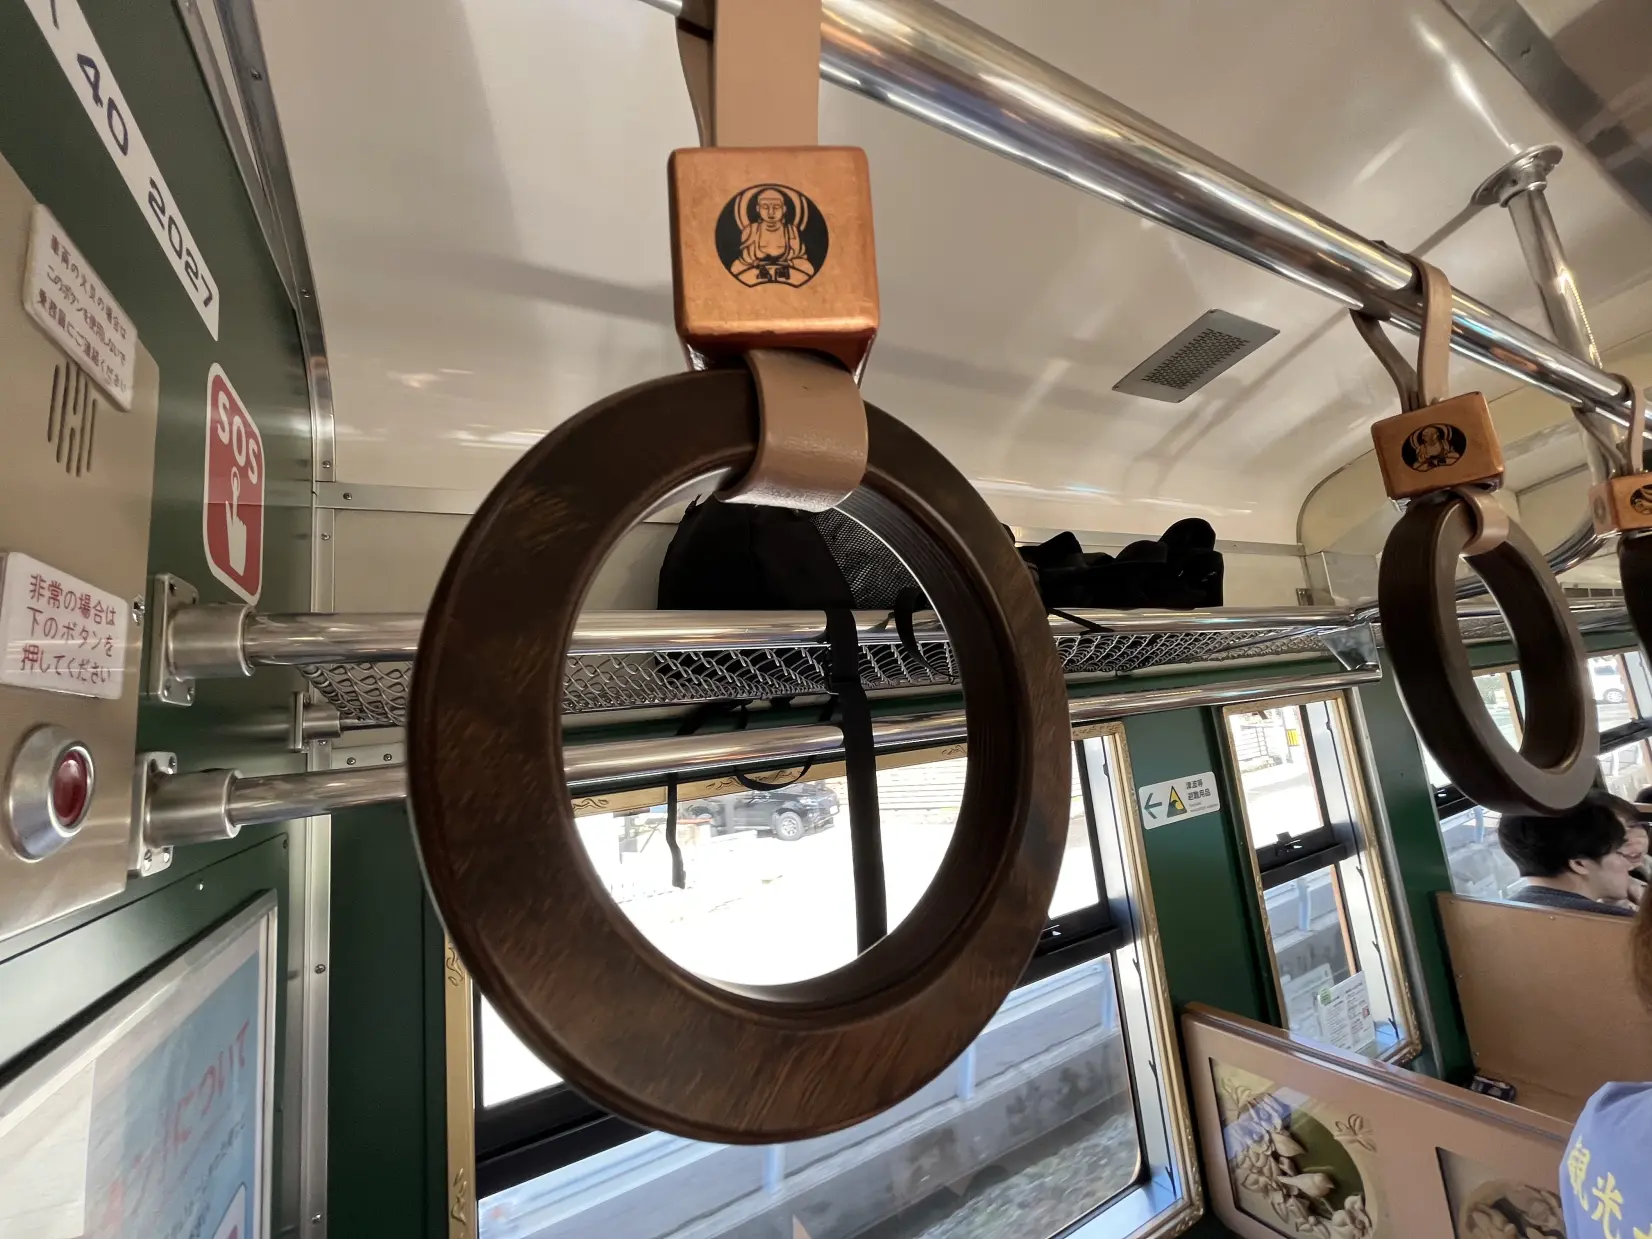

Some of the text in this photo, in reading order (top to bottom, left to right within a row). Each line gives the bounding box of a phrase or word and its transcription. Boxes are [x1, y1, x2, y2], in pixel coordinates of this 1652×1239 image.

[77, 53, 213, 308] 40 2027
[217, 390, 258, 485] SOS
[26, 606, 114, 658] 下のボタンを
[29, 573, 117, 627] 非常の場合は
[20, 643, 112, 685] 押してください
[1567, 1133, 1652, 1239] 観光
